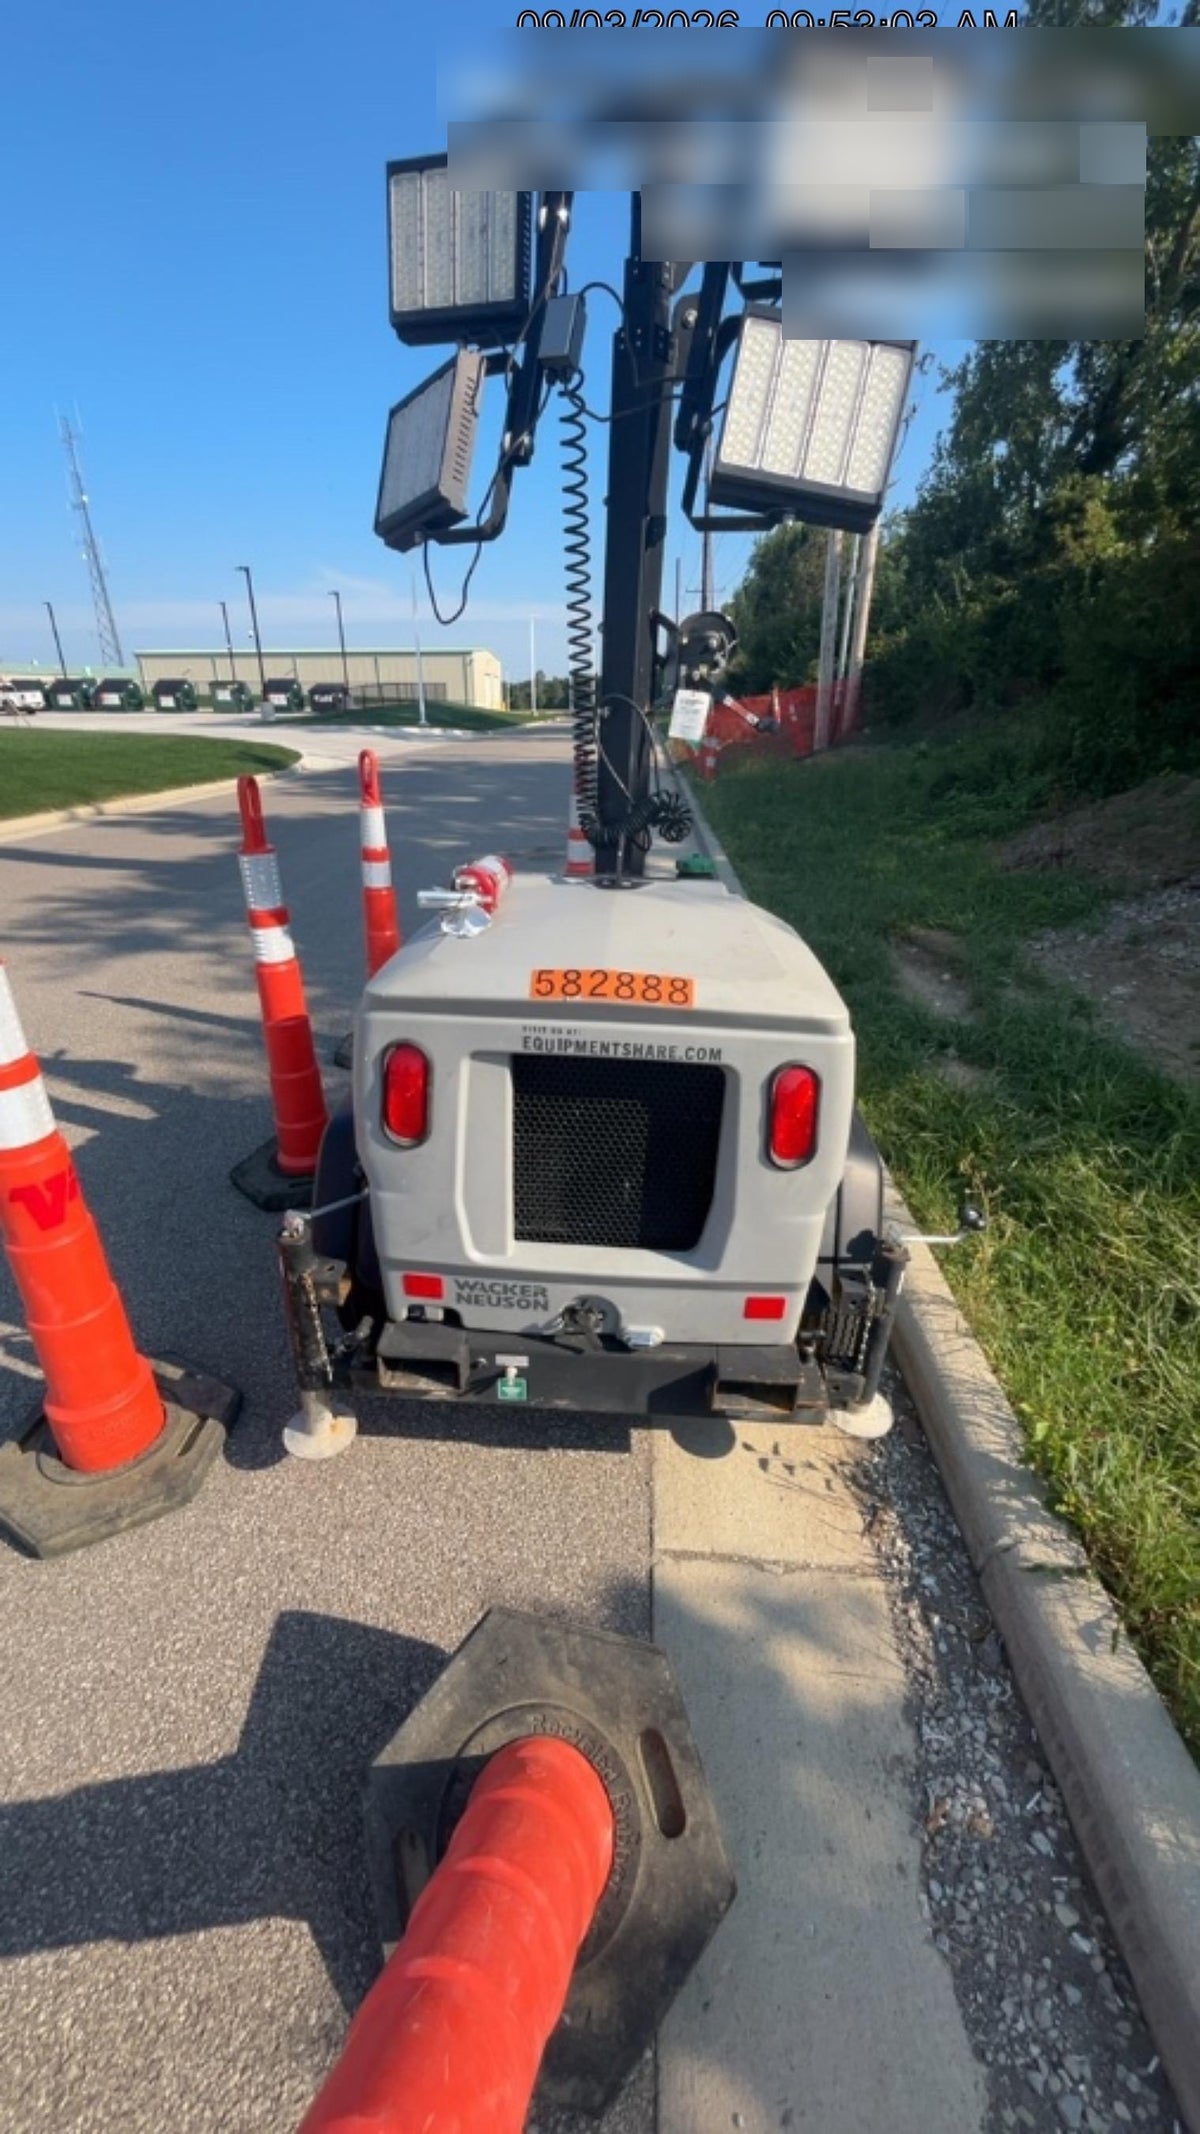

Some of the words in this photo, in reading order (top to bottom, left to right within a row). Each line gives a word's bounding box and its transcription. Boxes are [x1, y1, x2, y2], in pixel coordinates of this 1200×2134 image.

[535, 969, 689, 1005] 582888
[522, 1036, 722, 1061] EQUIPMENTSHARE.COM
[454, 1279, 547, 1298] WACKER
[456, 1293, 548, 1311] NEUSON
